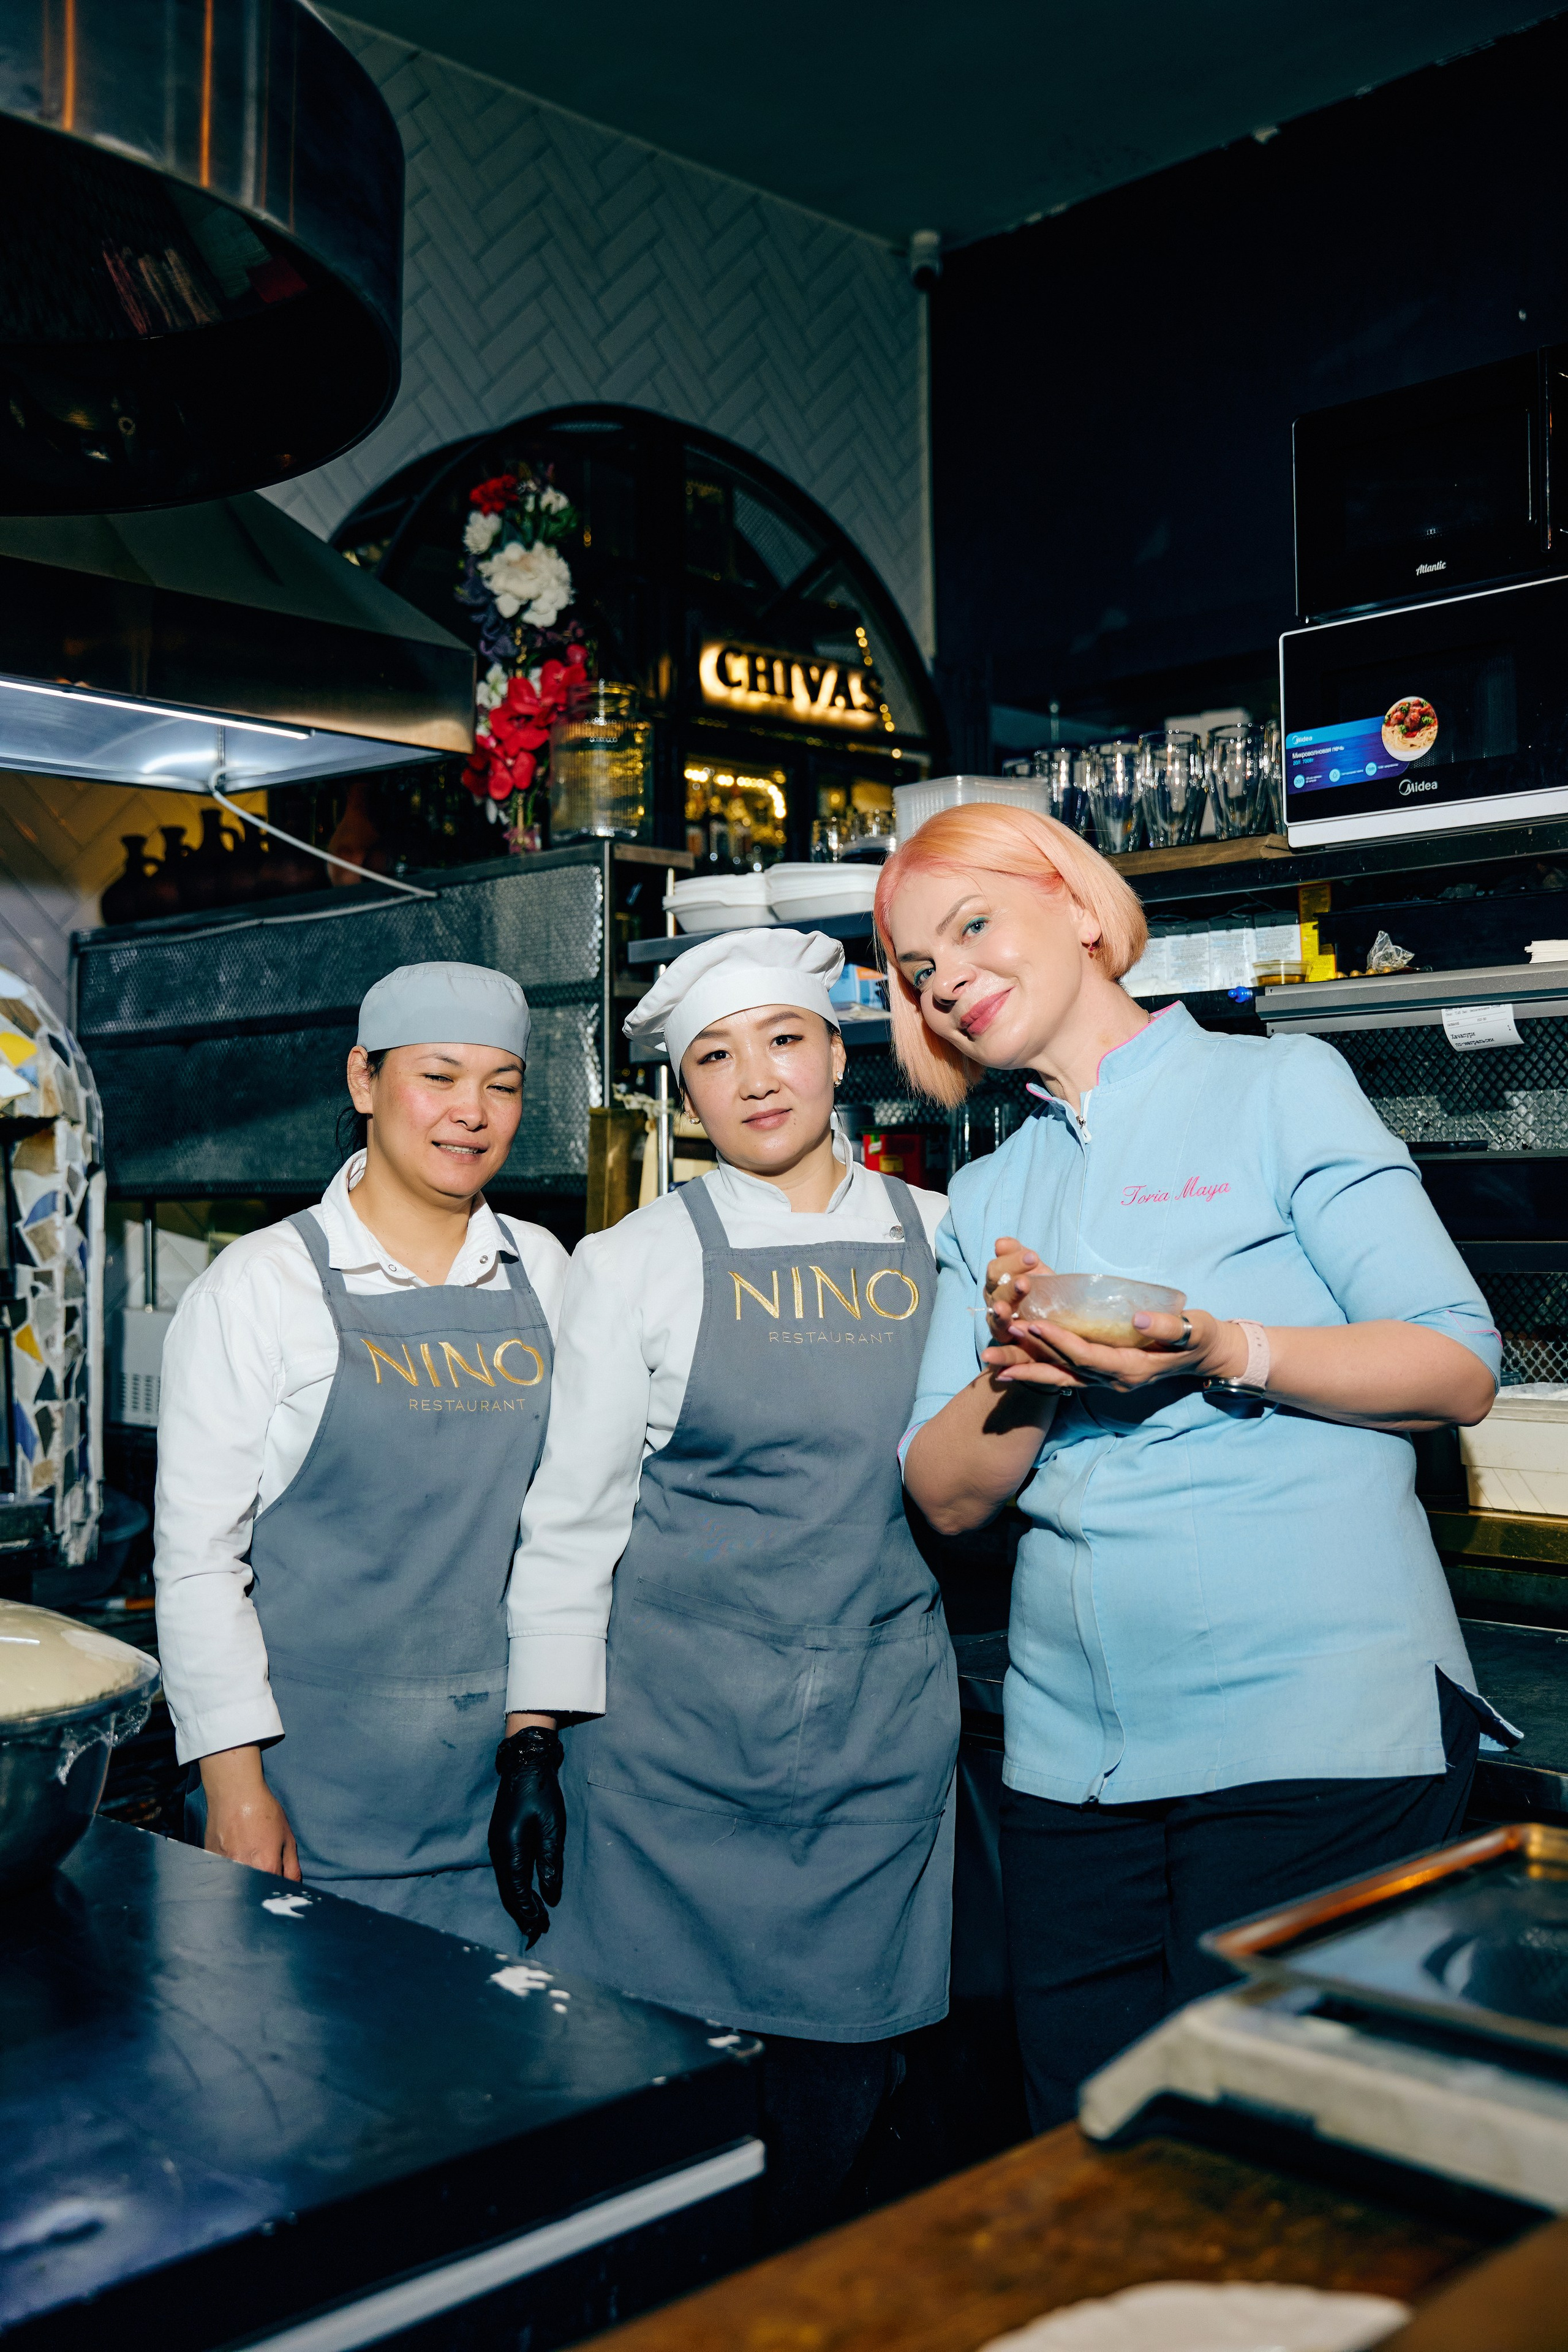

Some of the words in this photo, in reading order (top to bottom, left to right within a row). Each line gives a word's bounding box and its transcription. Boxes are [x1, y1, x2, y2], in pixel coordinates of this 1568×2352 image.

[1415, 560, 1446, 576] Atlantic
[716, 647, 884, 711] CHIVAS
[1292, 735, 1313, 745] Midea
[1292, 747, 1332, 760] Микроволновая
[1399, 778, 1438, 796] Midea
[1120, 1185, 1170, 1206] Toria
[1174, 1175, 1231, 1202] Maya
[728, 1265, 919, 1321] NINO
[769, 1331, 894, 1344] RESTAURANT
[360, 1338, 545, 1388] NINO
[409, 1398, 526, 1412] RESTAURANT
